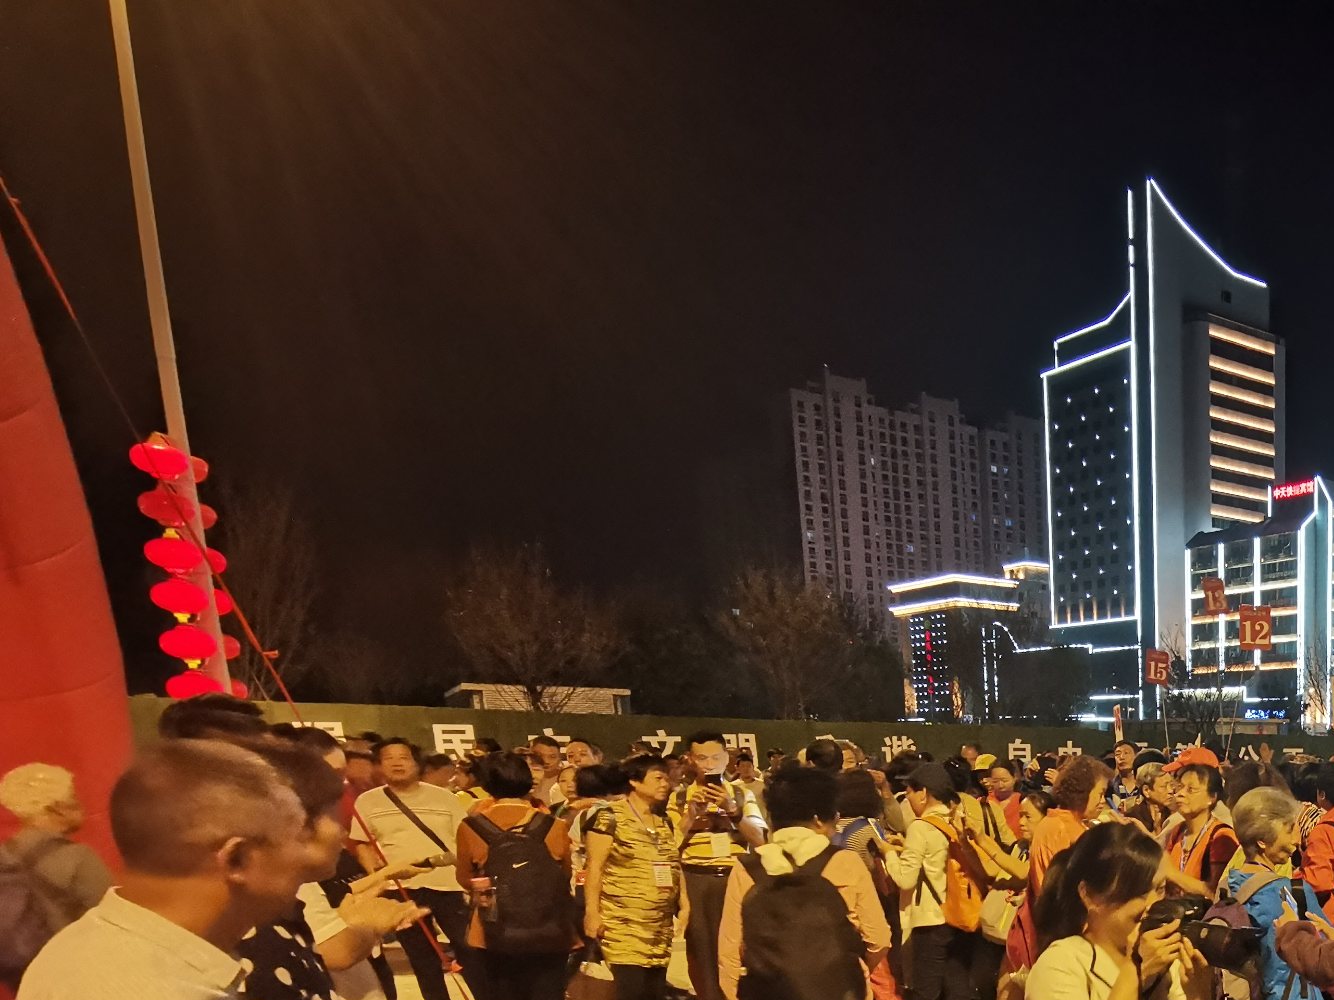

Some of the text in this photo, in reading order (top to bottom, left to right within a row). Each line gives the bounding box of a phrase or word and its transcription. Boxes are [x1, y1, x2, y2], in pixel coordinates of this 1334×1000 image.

[1206, 589, 1228, 610] 13
[1242, 620, 1270, 645] 12
[1148, 660, 1167, 681] 15
